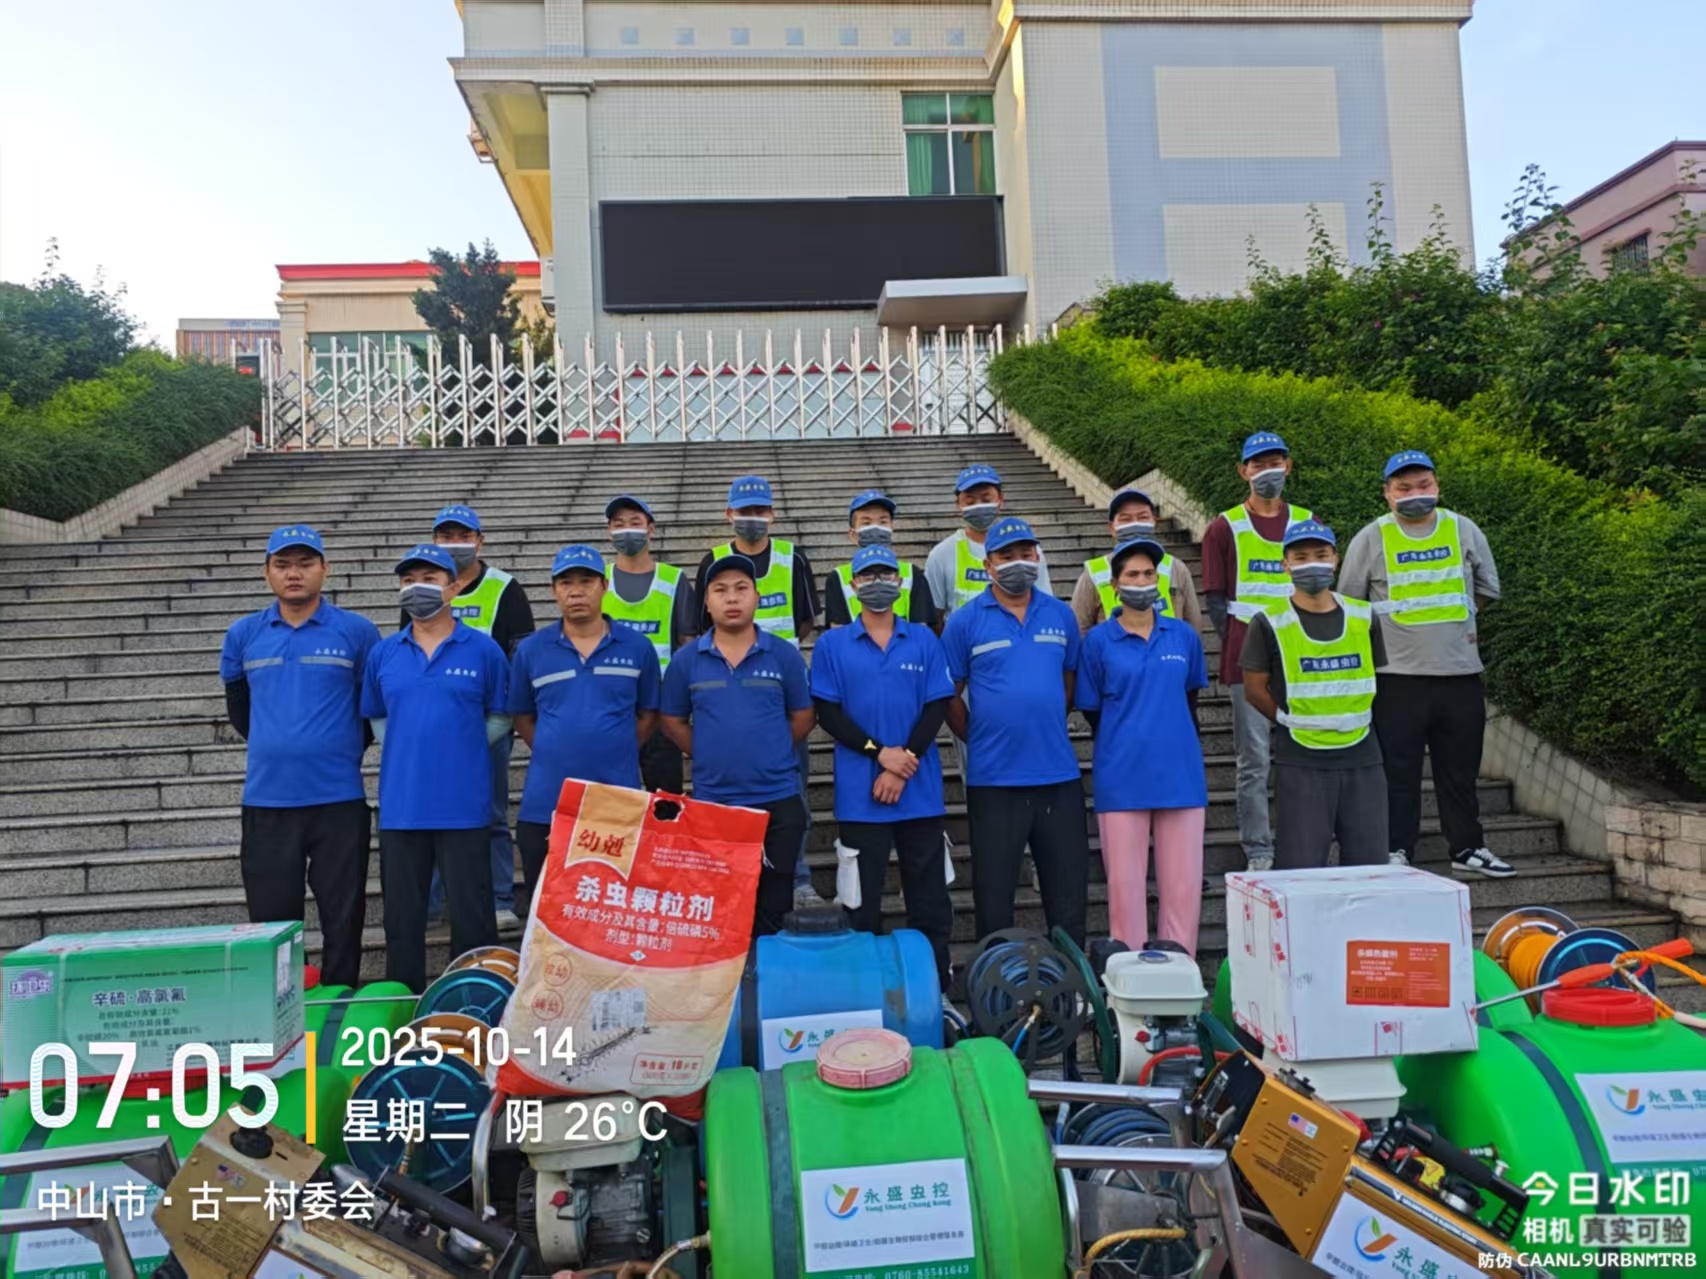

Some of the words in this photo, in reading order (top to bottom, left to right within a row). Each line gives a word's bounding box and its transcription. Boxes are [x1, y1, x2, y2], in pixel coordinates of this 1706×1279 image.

[575, 874, 715, 922] 杀虫颗粒剂
[863, 1182, 950, 1205] 永盛虫控
